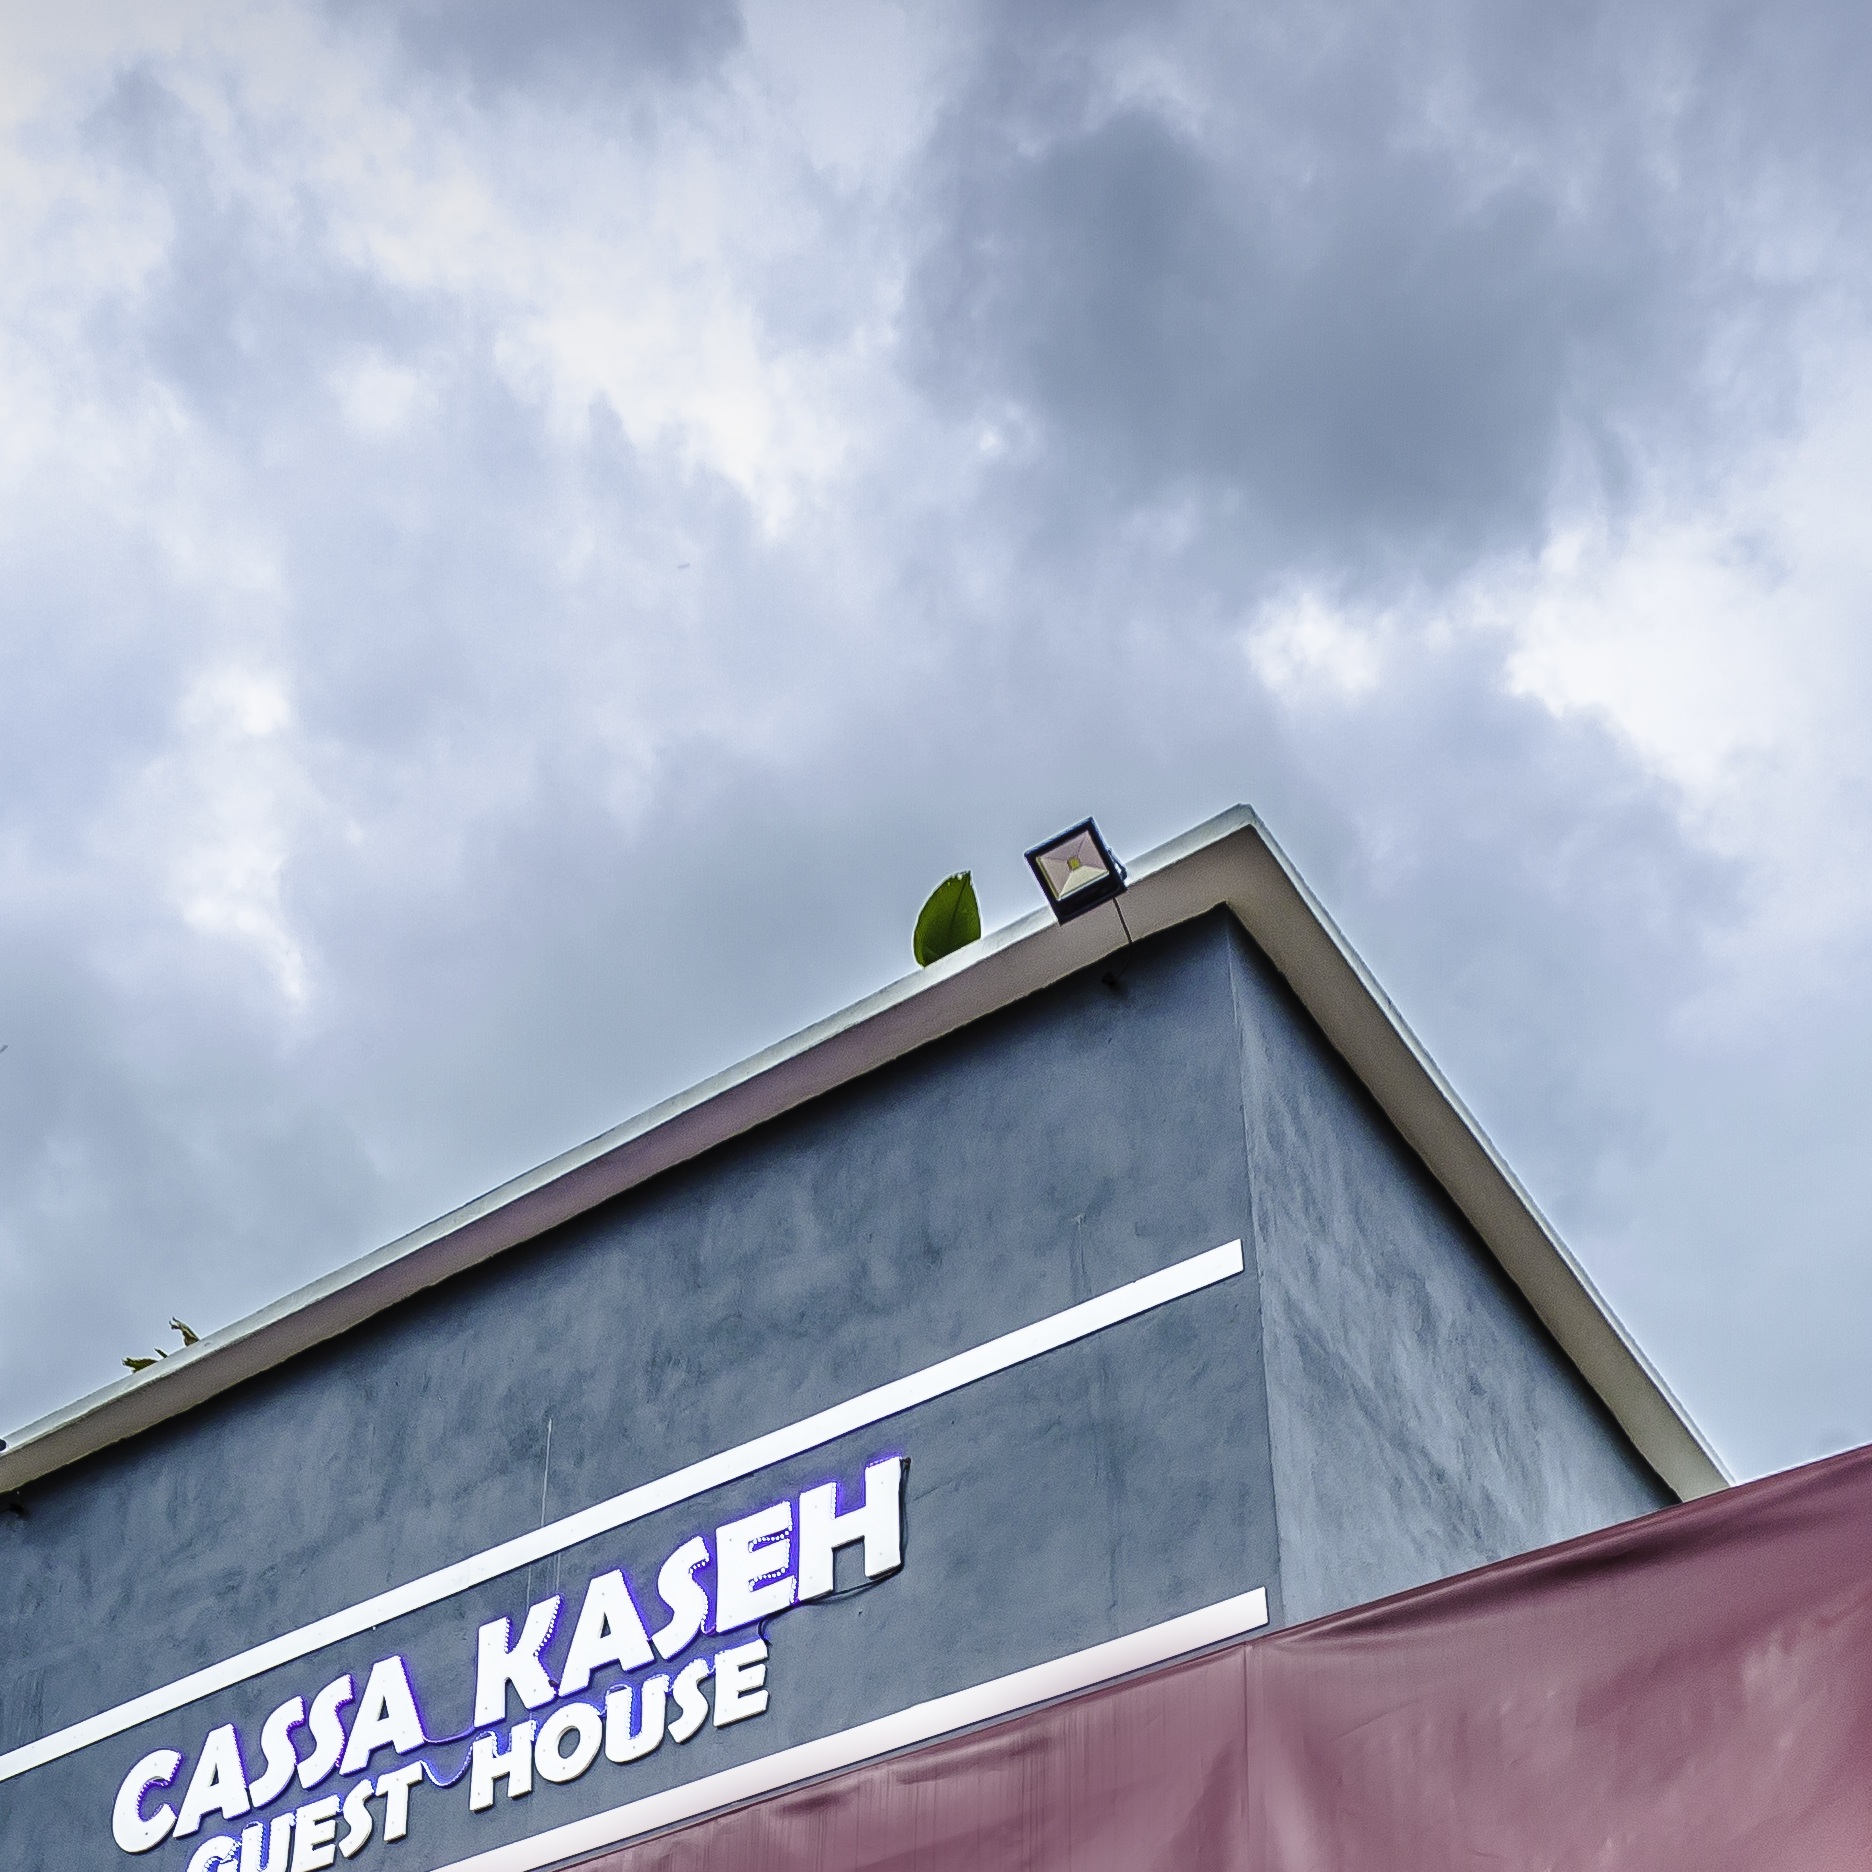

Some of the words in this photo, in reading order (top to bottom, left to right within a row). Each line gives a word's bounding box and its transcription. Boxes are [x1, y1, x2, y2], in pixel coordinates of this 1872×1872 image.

[112, 1654, 425, 1853] CASSA
[473, 1454, 904, 1728] KASEH
[469, 1640, 769, 1811] HOUSE
